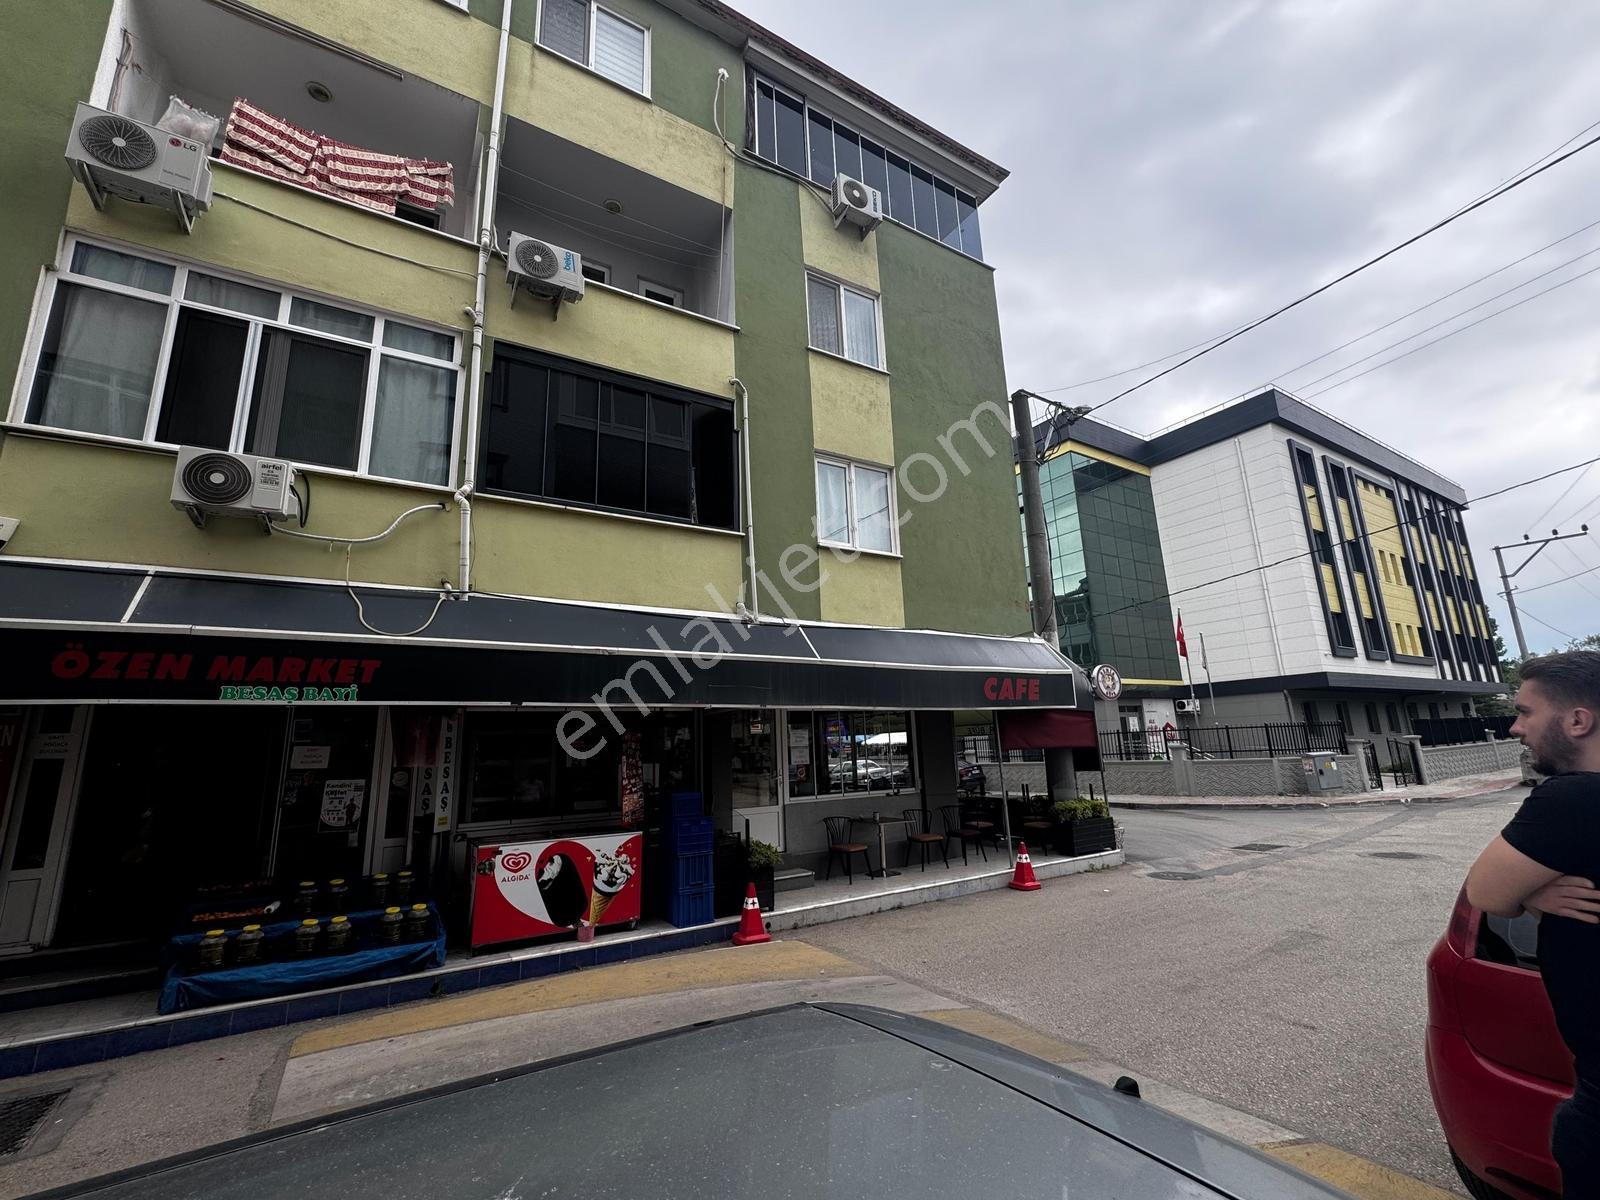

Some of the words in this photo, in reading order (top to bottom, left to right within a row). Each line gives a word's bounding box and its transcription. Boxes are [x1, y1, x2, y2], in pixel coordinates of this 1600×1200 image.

[183, 142, 198, 152] LG
[563, 251, 572, 271] beko
[51, 642, 194, 680] ÖZEN
[206, 655, 382, 684] MARKET
[219, 685, 299, 704] BESAŞ
[302, 684, 358, 702] BAYİ
[983, 676, 1040, 701] CAFE
[501, 874, 530, 883] ALGIDA
